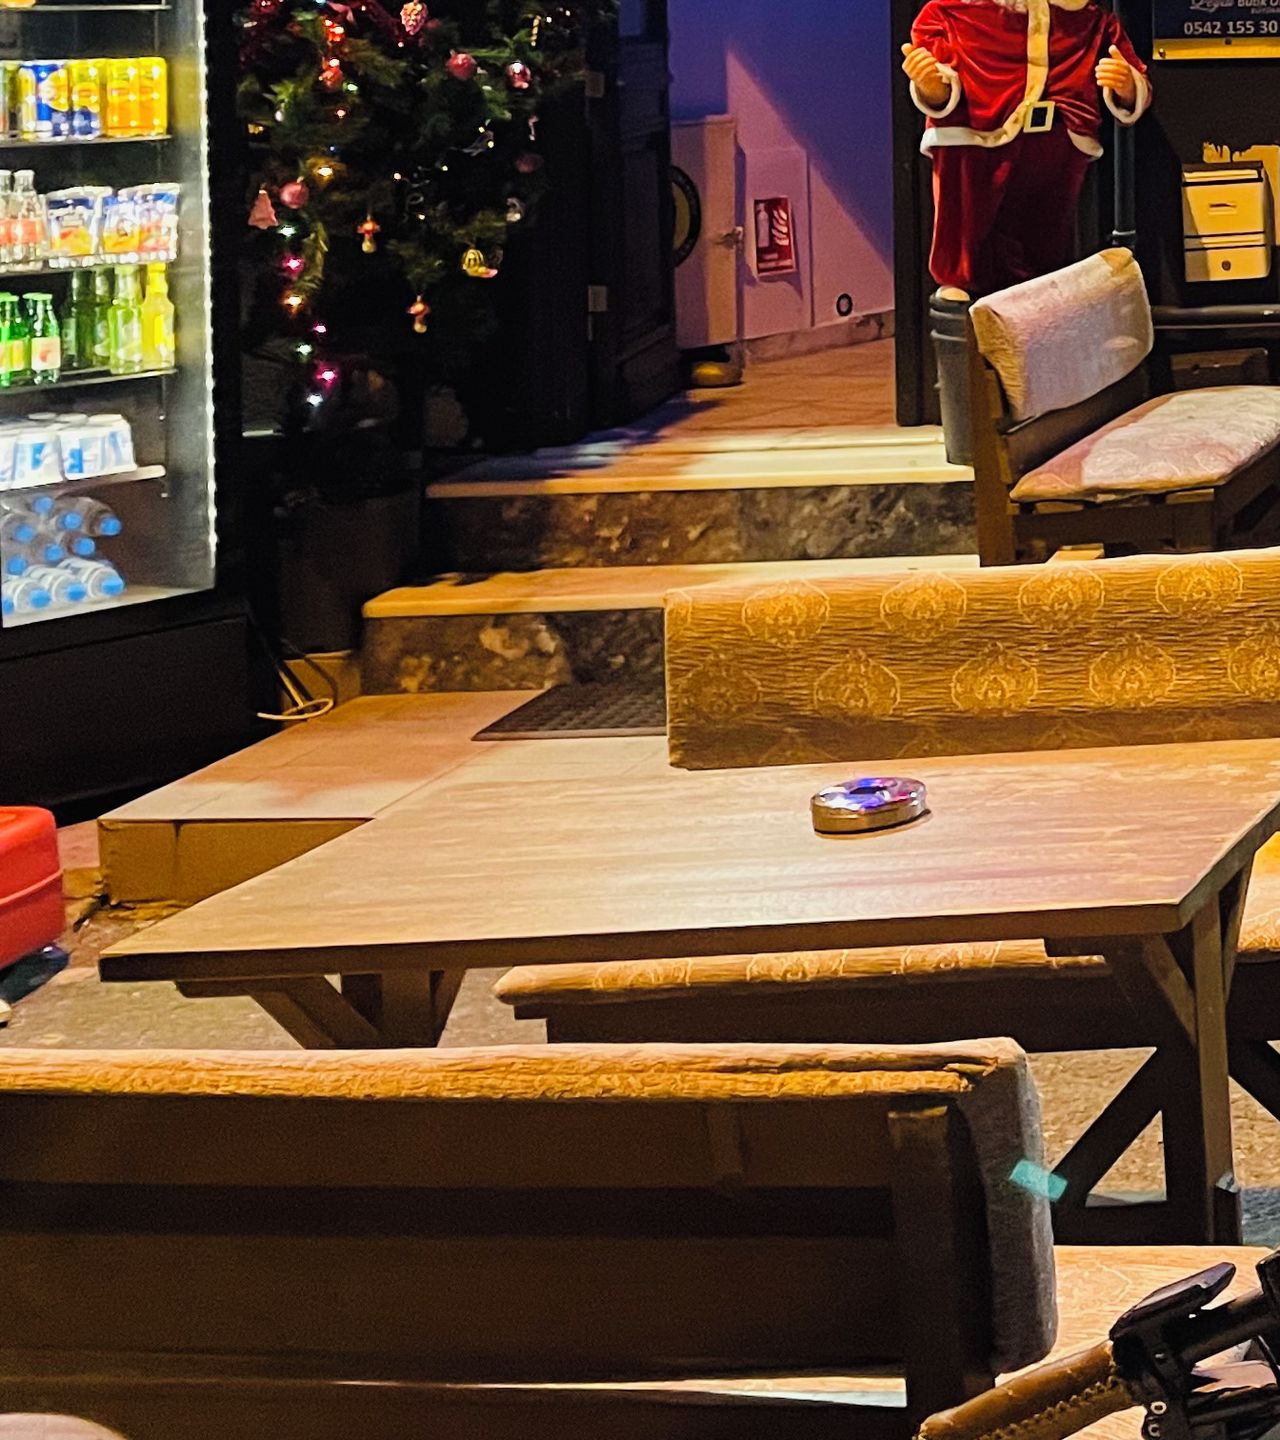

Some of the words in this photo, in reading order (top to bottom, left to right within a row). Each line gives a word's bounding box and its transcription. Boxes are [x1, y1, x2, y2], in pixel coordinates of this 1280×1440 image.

[1183, 21, 1222, 35] 0542
[1226, 20, 1255, 34] 155
[1259, 20, 1279, 34] 30
